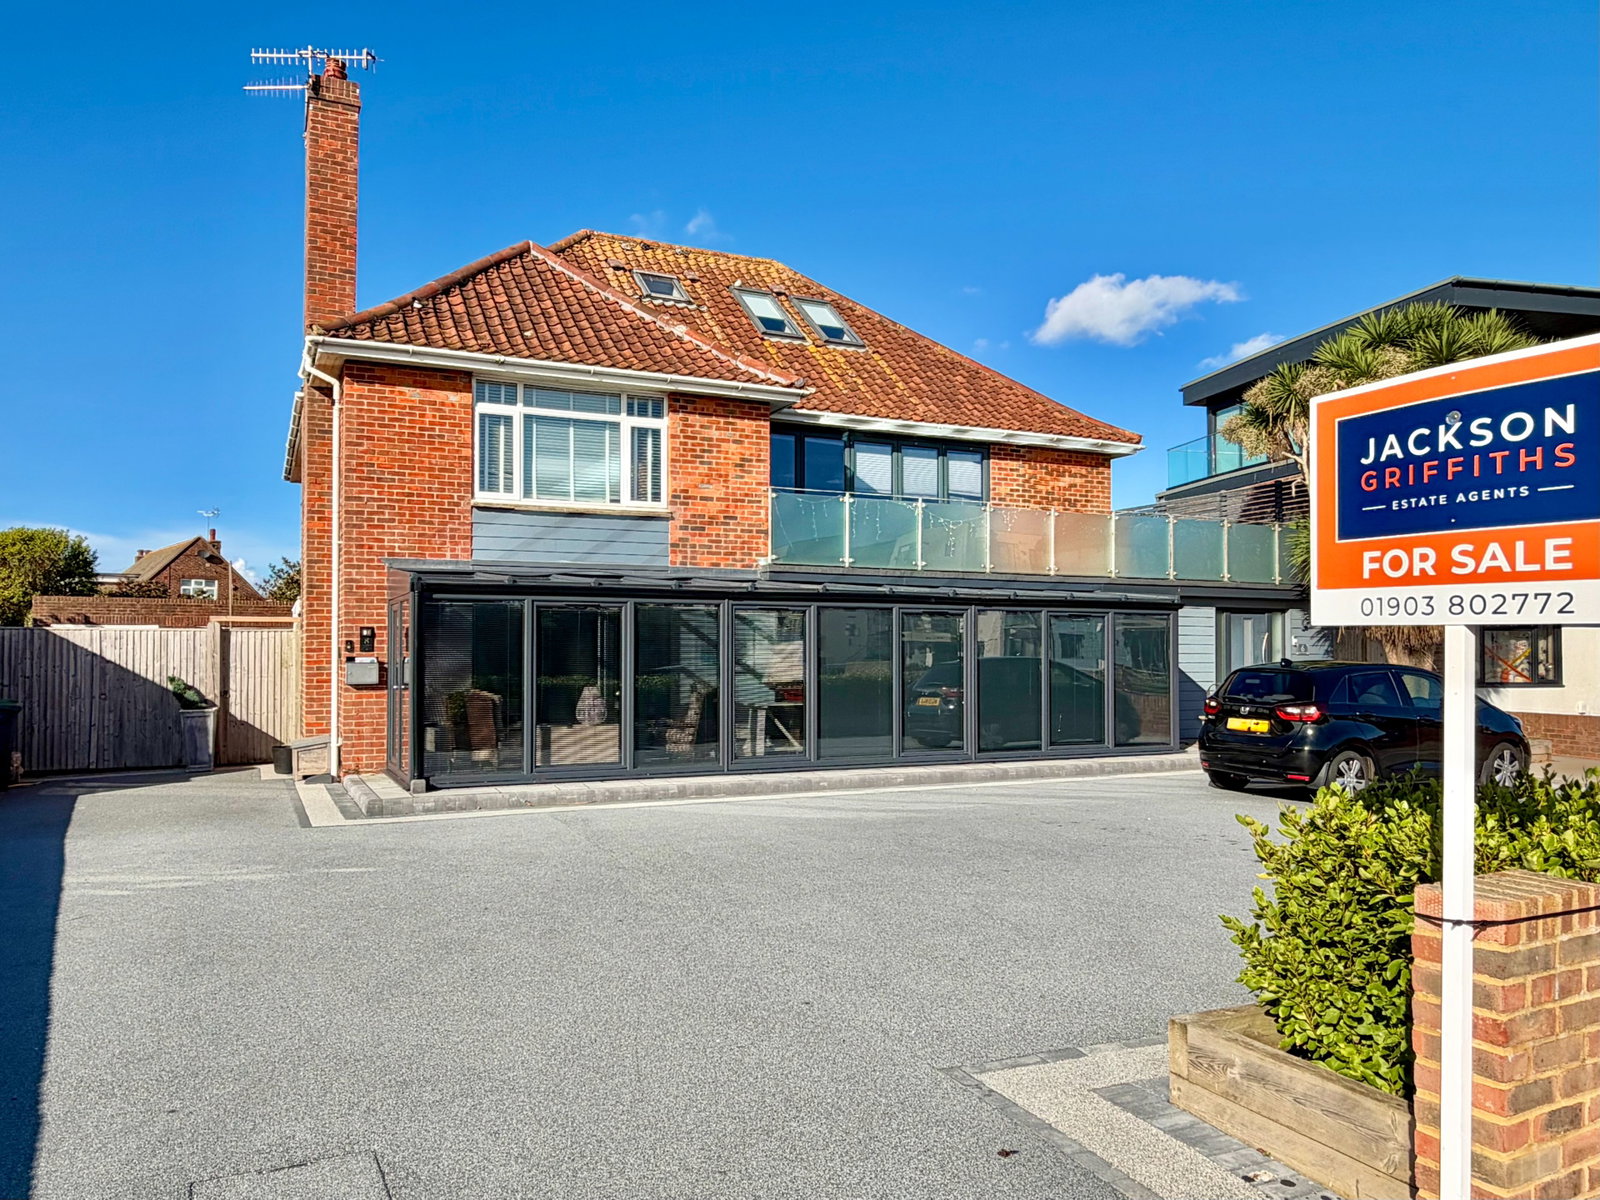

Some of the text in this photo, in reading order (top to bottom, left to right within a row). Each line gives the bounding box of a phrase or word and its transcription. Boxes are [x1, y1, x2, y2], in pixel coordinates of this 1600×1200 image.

[1360, 404, 1576, 465] JACKSON
[1360, 443, 1577, 492] GRIFFITHS
[1392, 486, 1530, 510] ESTATE AGENTS
[1362, 537, 1573, 579] FOR SALE
[1360, 591, 1576, 617] 01903 802772
